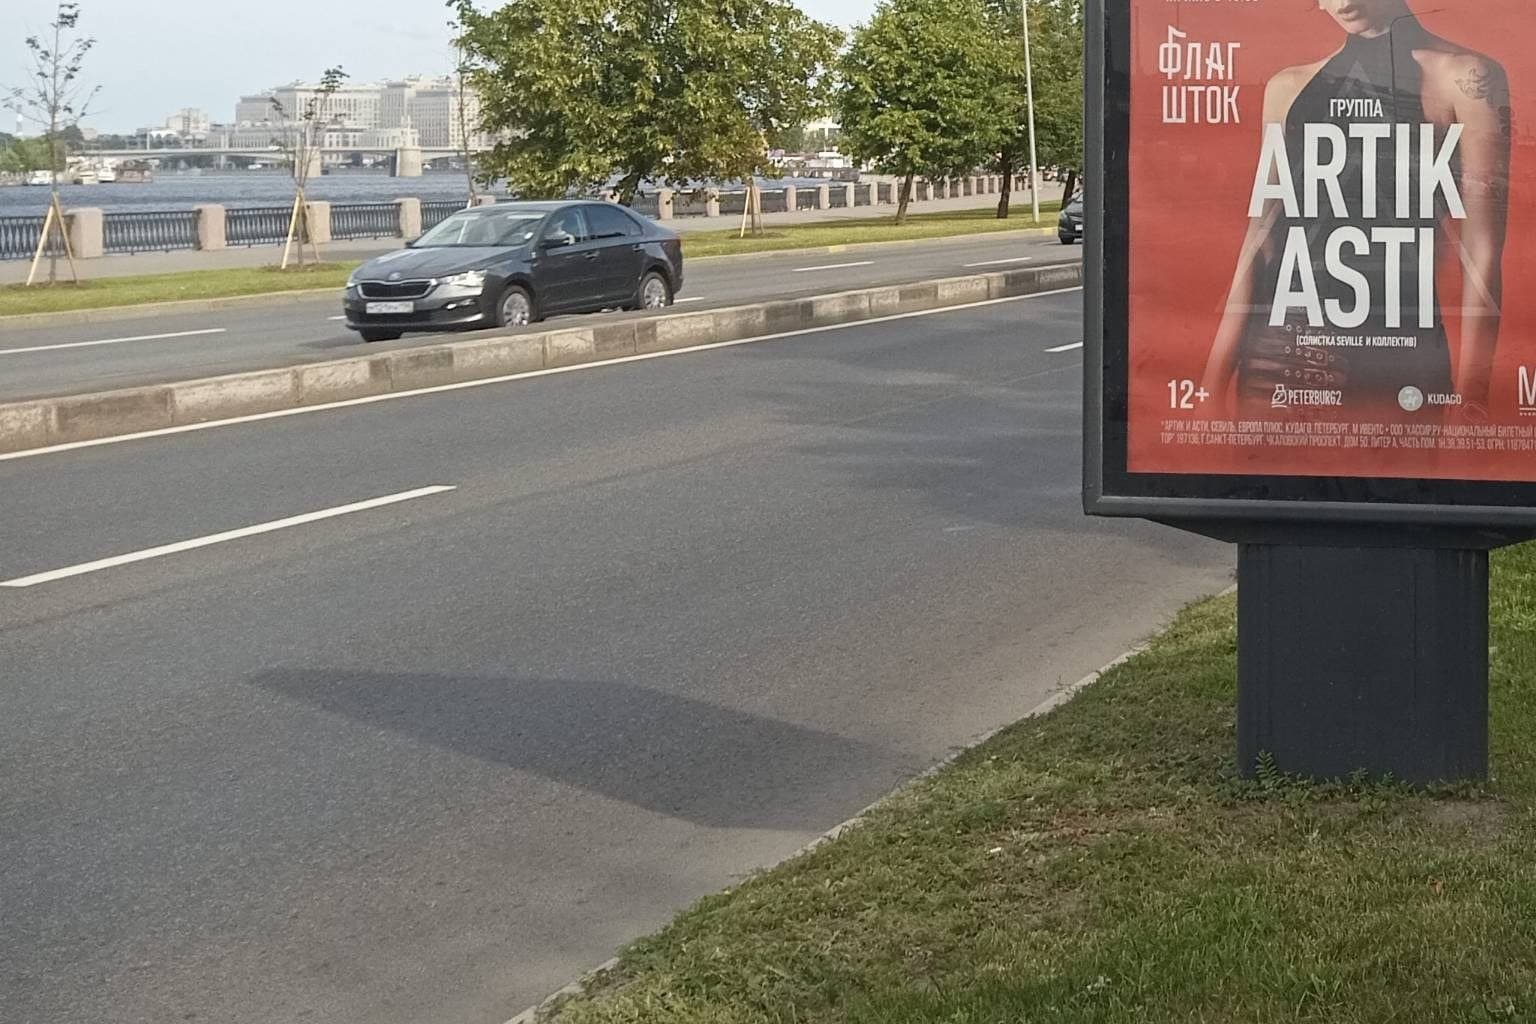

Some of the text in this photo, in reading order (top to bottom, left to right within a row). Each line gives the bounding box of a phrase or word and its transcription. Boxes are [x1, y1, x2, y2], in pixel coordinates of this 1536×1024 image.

[1159, 26, 1241, 80] ФЛАГ
[1162, 86, 1240, 124] ШТОК
[1330, 98, 1383, 118] ГРУППА
[1248, 122, 1467, 220] ARTIK
[1268, 226, 1434, 329] ASTI
[1296, 335, 1417, 349] (СОЛИСТКА SEVILLE И КОЛЛЕКТИВ)
[1167, 380, 1210, 410] 12+
[1288, 389, 1342, 406] PETERBURG2
